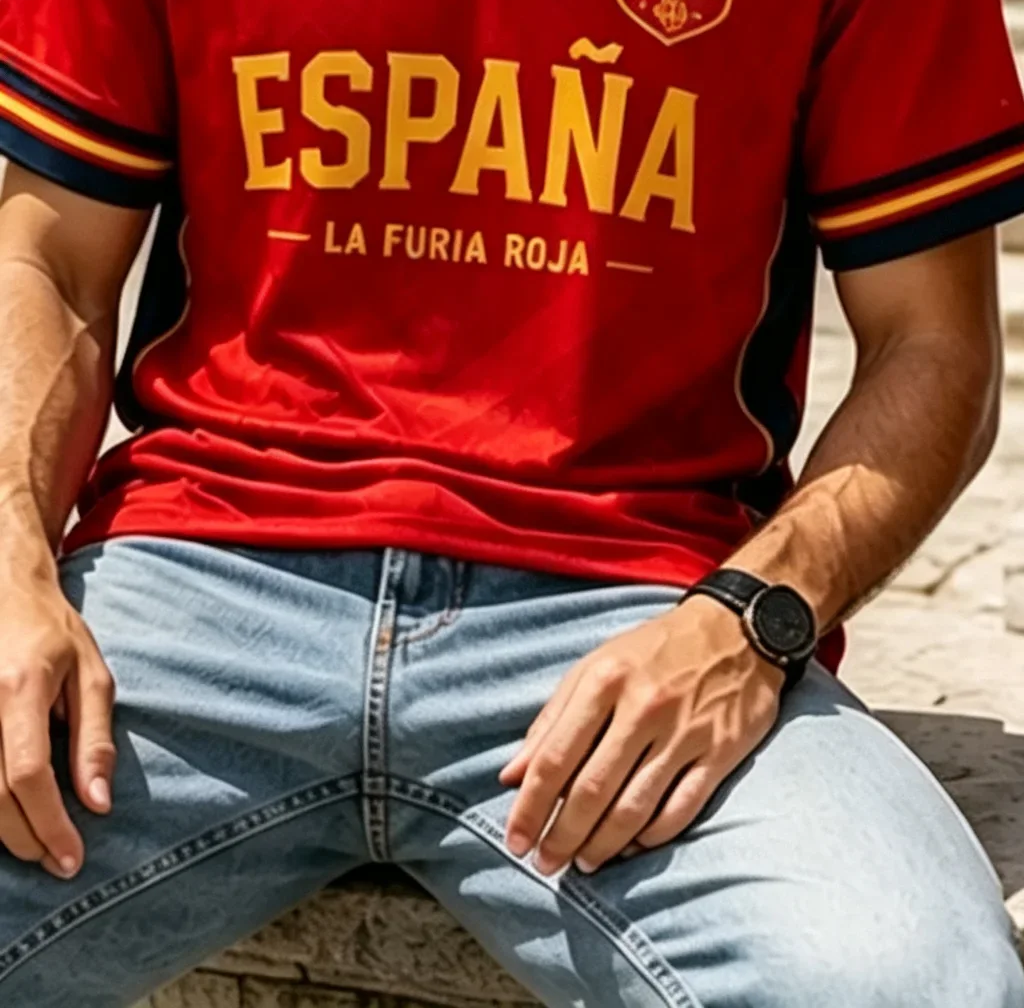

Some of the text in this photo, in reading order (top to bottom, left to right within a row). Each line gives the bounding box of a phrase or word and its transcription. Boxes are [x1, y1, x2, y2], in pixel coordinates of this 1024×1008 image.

[232, 37, 698, 233] ESPAÑA
[324, 221, 589, 276] LA FURIA ROJA
